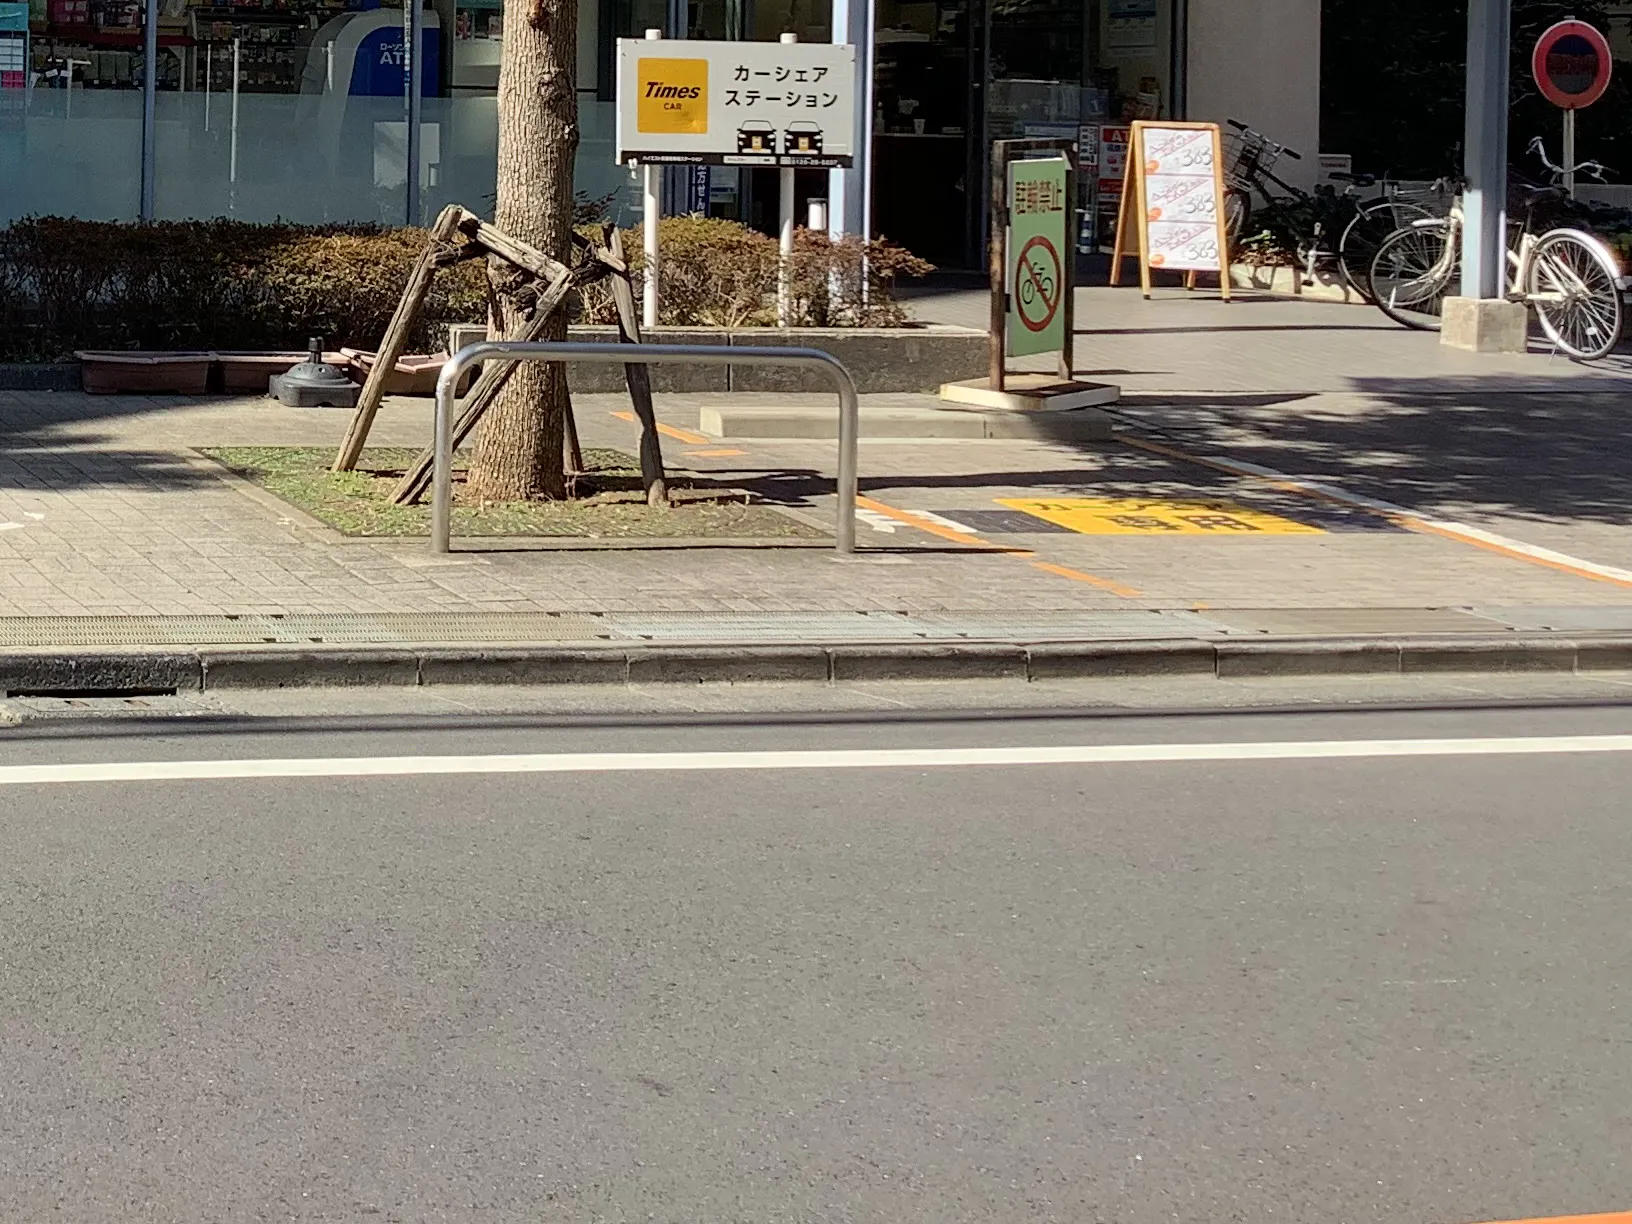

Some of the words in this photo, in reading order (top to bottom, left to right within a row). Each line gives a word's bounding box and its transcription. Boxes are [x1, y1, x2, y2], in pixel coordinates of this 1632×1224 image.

[379, 51, 406, 65] AT
[734, 65, 829, 83] カーシェア
[645, 81, 701, 99] Times
[725, 89, 838, 109] ステーション
[663, 102, 682, 111] CAR
